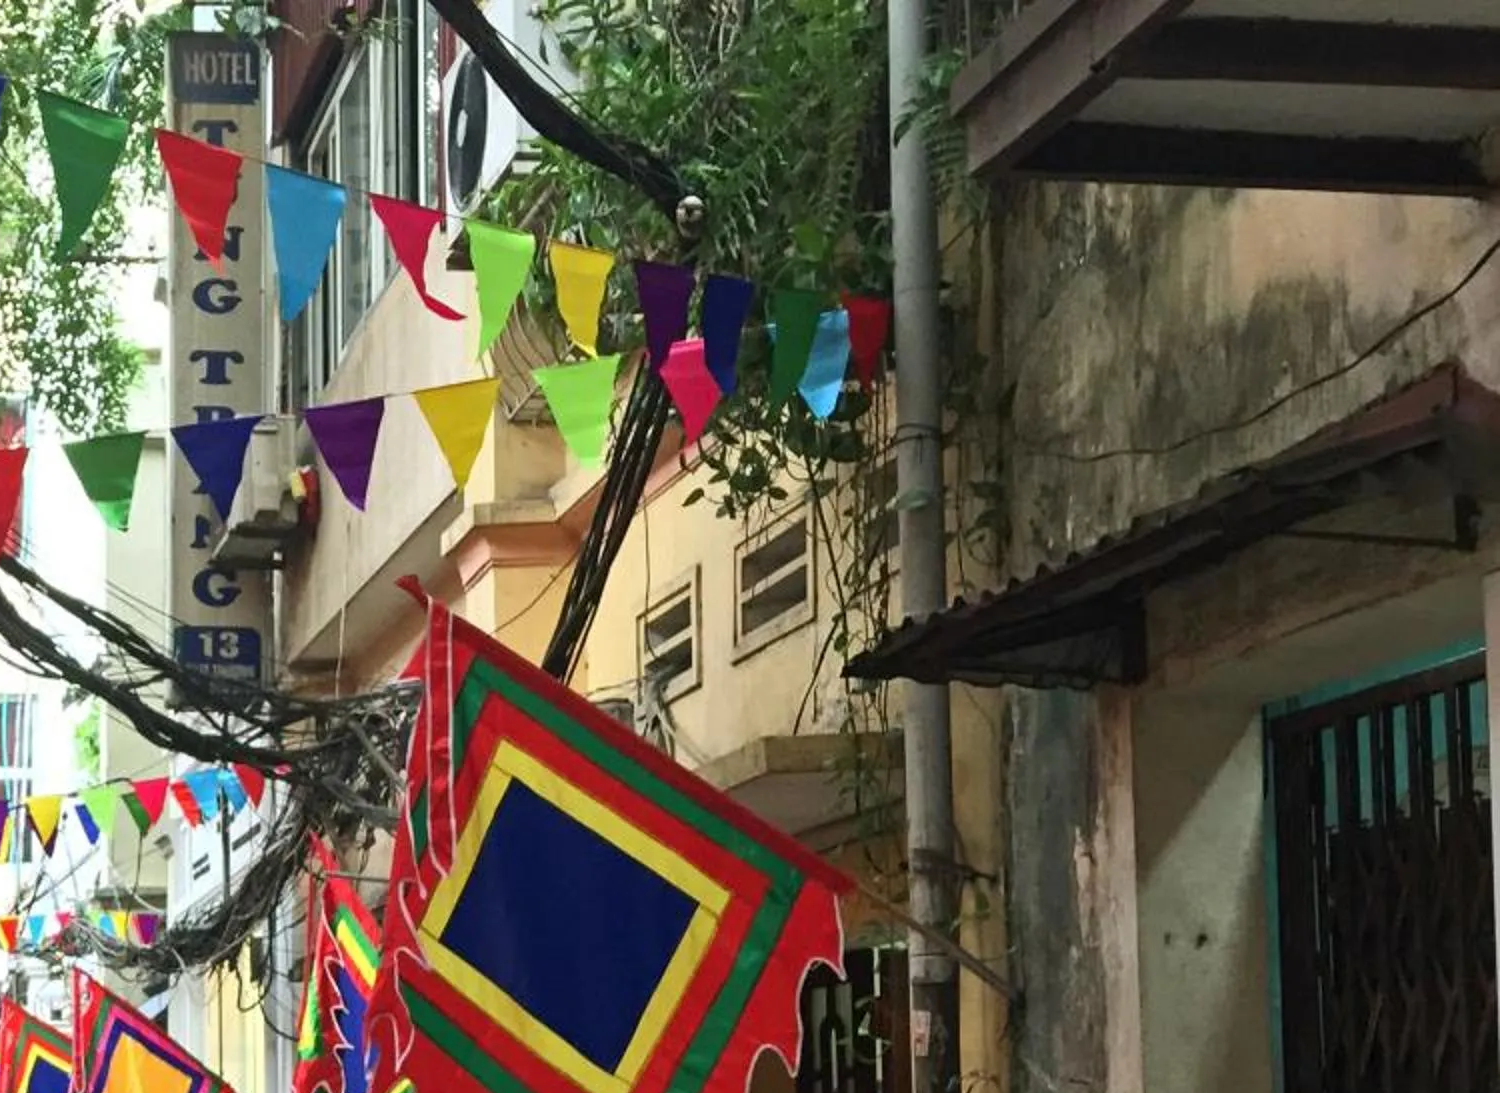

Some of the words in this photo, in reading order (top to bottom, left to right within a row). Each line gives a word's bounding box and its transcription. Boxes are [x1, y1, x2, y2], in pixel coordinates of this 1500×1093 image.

[183, 52, 257, 86] HOTEL
[192, 119, 245, 315] TNG
[198, 631, 239, 660] 13
